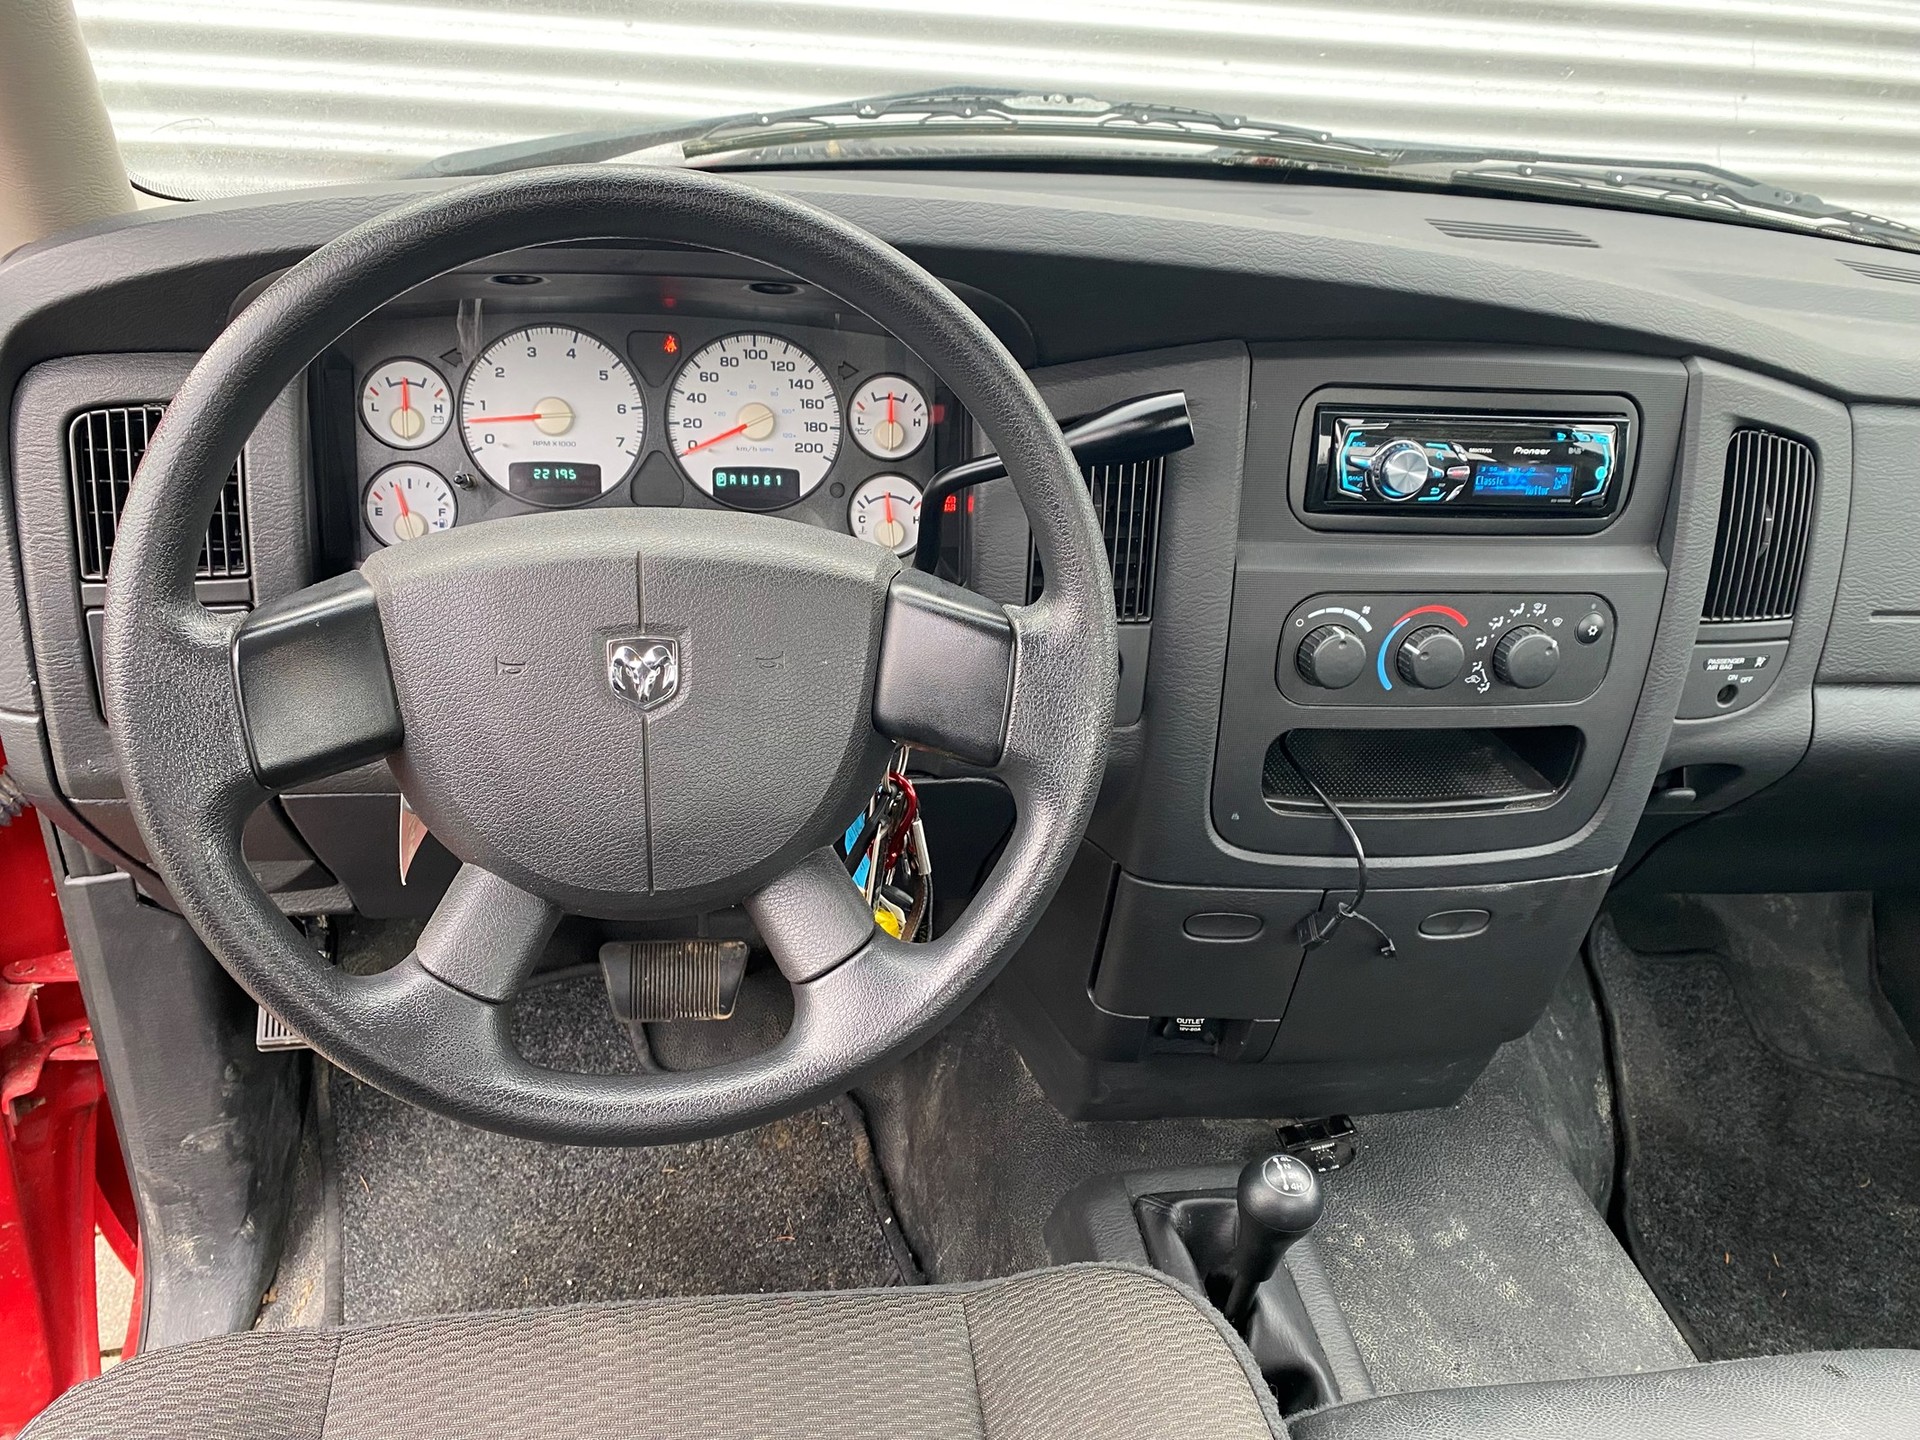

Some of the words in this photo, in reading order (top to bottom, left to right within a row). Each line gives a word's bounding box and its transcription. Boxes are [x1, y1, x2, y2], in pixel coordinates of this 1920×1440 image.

[526, 346, 537, 358] 3
[566, 347, 577, 360] 4
[743, 349, 768, 360] 100
[720, 356, 739, 368] 80
[771, 360, 796, 372] 120
[494, 367, 505, 379] 2
[599, 370, 609, 381] 5
[700, 371, 719, 383] 60
[788, 379, 814, 390] 140
[687, 392, 707, 404] 40
[371, 403, 379, 412] L
[434, 405, 443, 414] H
[480, 400, 487, 411] 1
[617, 404, 627, 415] 6
[800, 398, 824, 410] 160
[683, 418, 702, 429] 20
[804, 421, 828, 433] 180
[857, 417, 864, 426] L
[913, 418, 921, 427] H
[484, 433, 495, 444] 0
[615, 437, 625, 448] 7
[794, 443, 824, 454] 200
[1513, 446, 1551, 456] Pioneer
[533, 468, 577, 480] 22195
[1475, 475, 1504, 486] Classic
[375, 507, 383, 516] E
[439, 508, 446, 517] F
[858, 515, 866, 524] C
[1290, 1182, 1303, 1191] 4H
